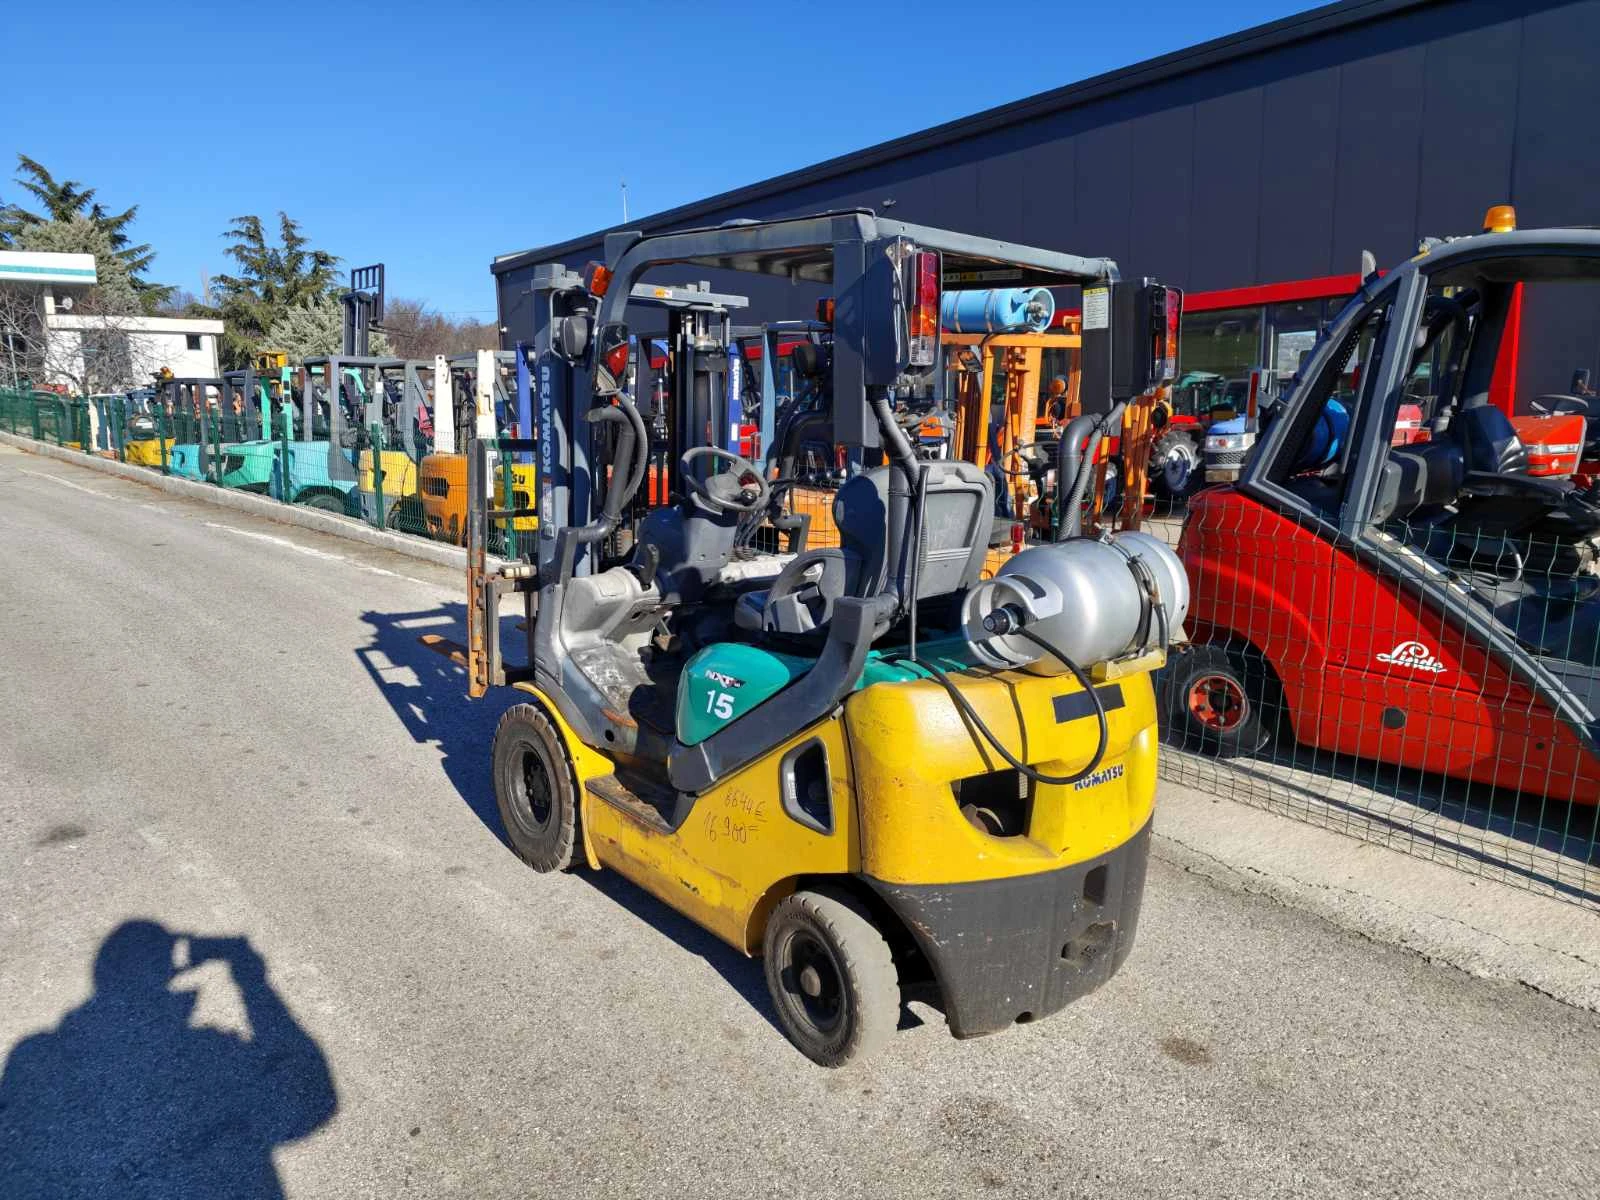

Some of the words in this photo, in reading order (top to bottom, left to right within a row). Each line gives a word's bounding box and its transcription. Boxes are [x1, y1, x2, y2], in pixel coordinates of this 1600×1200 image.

[541, 366, 551, 474] KOMATSU
[1376, 641, 1447, 673] Linde
[707, 690, 735, 719] 15
